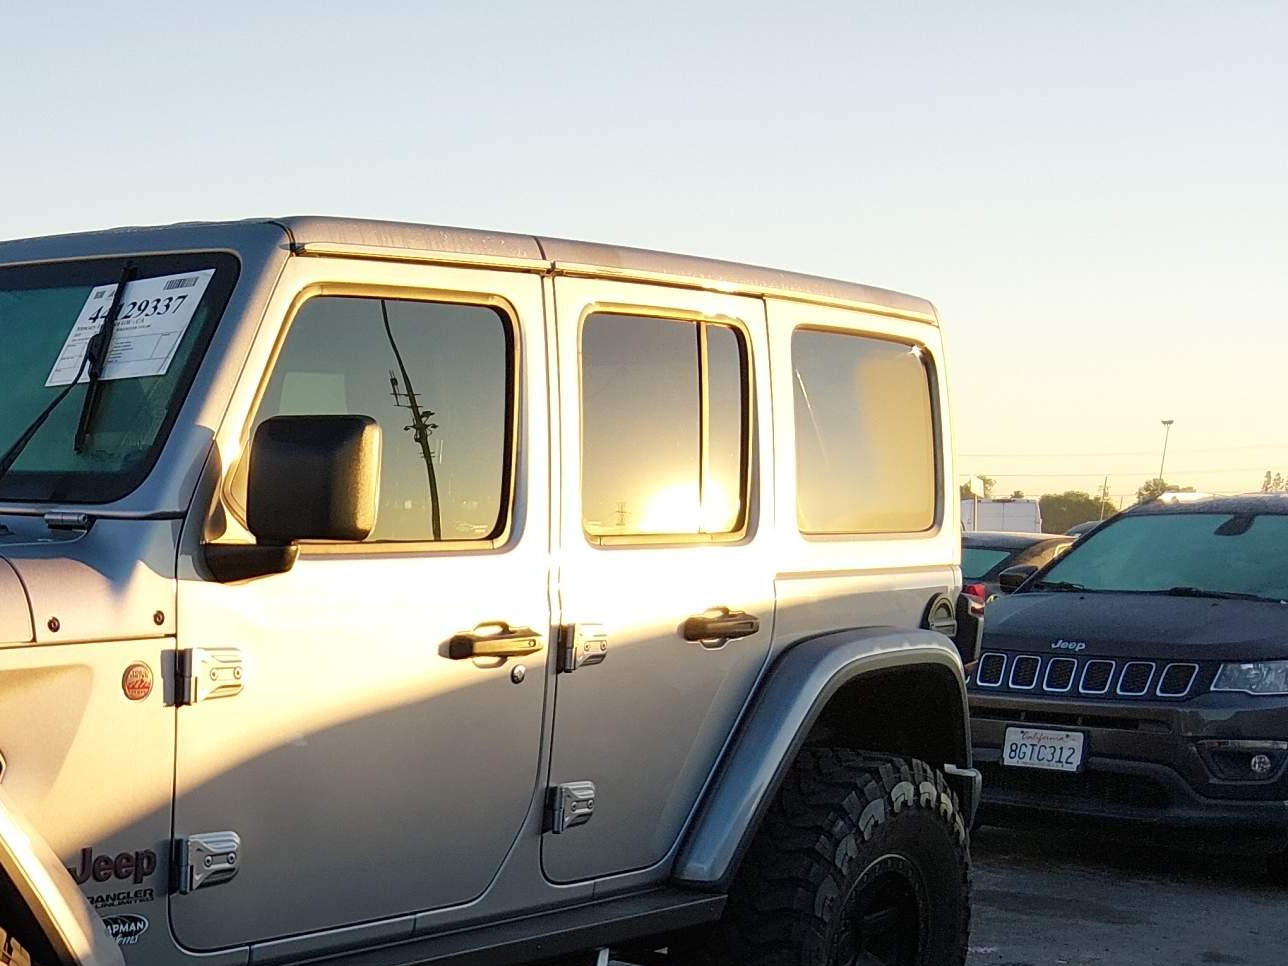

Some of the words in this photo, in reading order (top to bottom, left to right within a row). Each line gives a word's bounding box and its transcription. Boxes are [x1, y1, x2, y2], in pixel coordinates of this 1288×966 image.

[1051, 639, 1086, 652] Jeep
[1008, 742, 1076, 765] 8GTC312
[68, 847, 157, 885] Jeep
[87, 888, 154, 904] RANGLER
